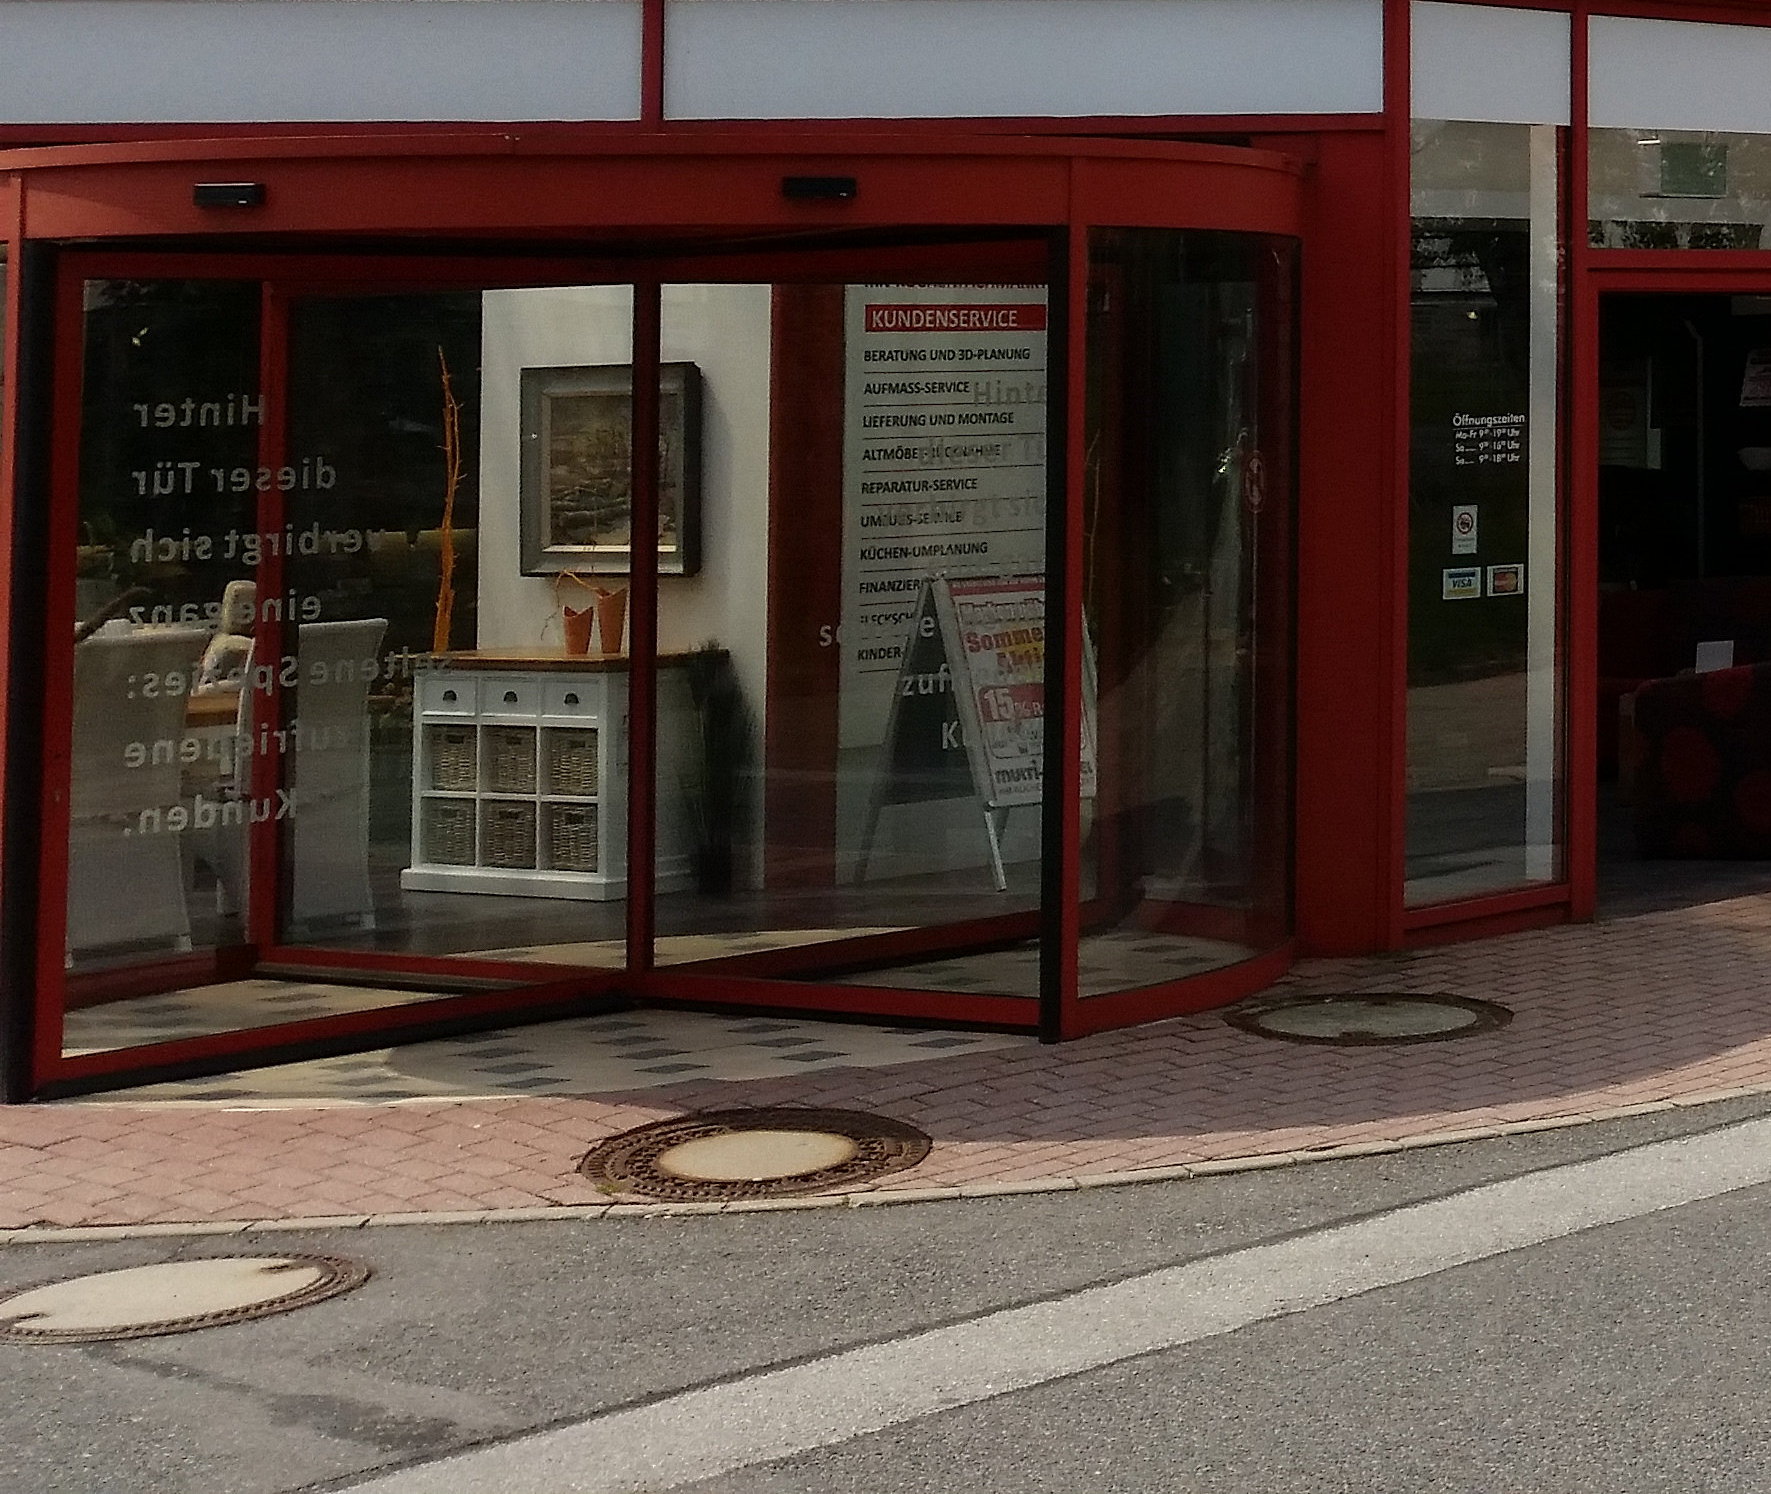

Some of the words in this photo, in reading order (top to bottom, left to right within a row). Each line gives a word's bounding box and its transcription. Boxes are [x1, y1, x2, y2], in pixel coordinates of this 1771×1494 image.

[872, 310, 1018, 328] KUNDENSERVICE
[864, 350, 926, 362] BERATUNG
[930, 350, 955, 361] UND
[958, 348, 1031, 361] 3D-PLANUNG
[864, 381, 970, 395] AUFMASS-SERVICE
[863, 415, 926, 428] LIEFERUNG
[929, 414, 955, 426] UND
[957, 412, 1014, 425] MONTAGE
[1452, 412, 1525, 427] Öffnungszeiten
[861, 478, 978, 495] REPARATUR-SERVICE
[860, 542, 988, 561] KÜCHEN-UMPLANUNG
[1452, 579, 1472, 588] VISA
